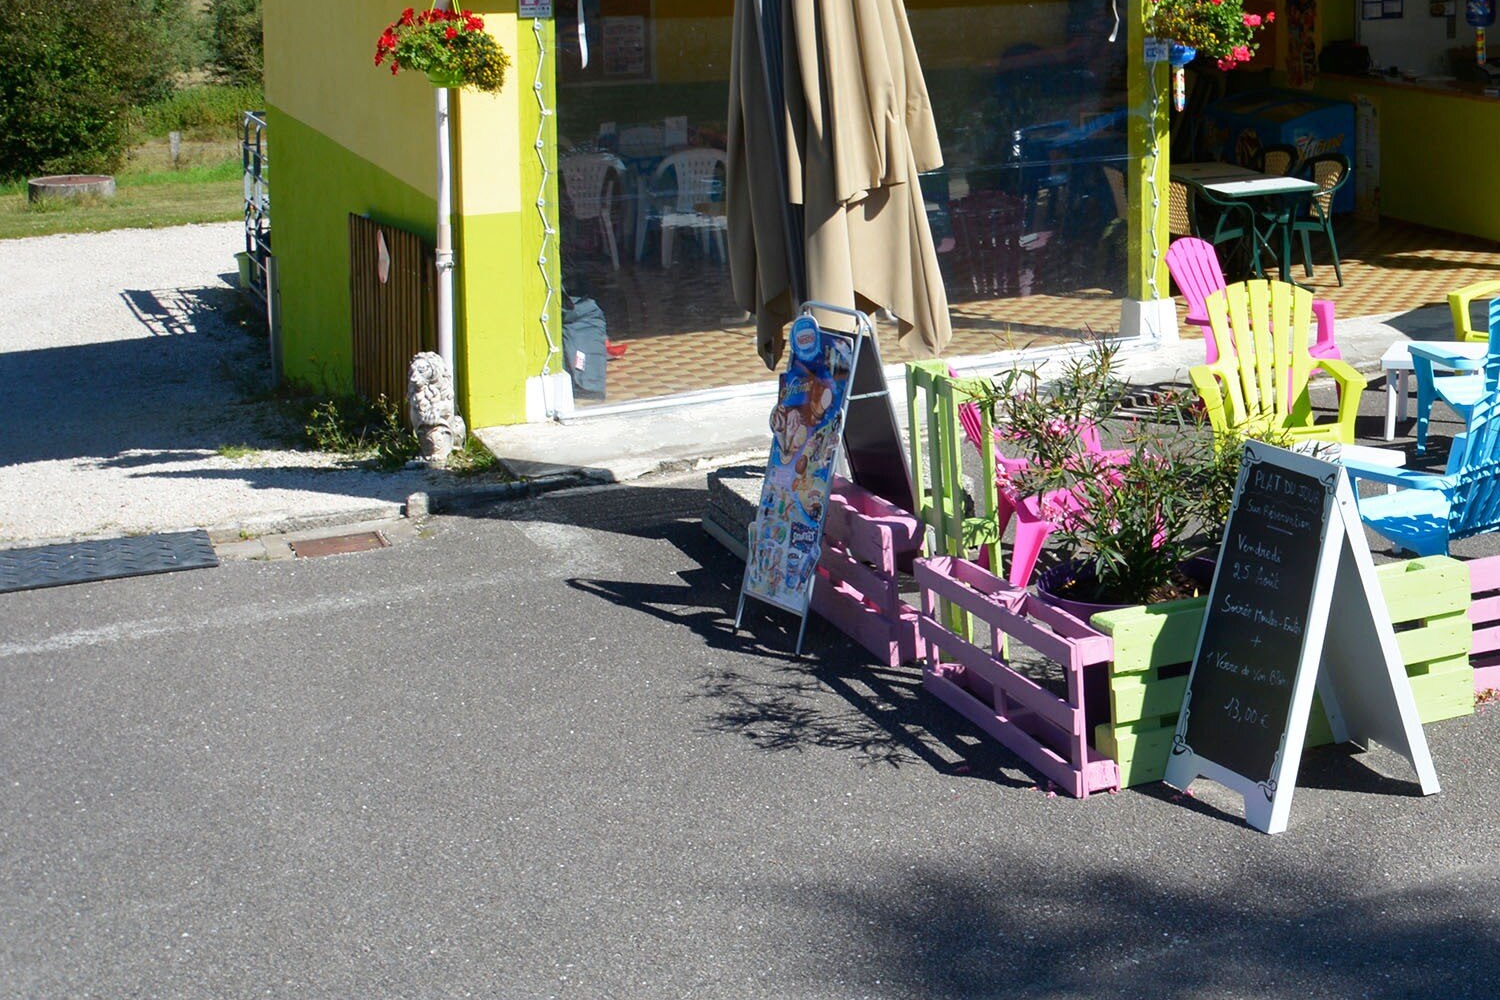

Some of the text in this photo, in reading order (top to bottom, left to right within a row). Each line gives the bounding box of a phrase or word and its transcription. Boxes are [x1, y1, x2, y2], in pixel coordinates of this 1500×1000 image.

[1255, 470, 1280, 491] PLAT
[1284, 479, 1297, 495] DU
[1238, 534, 1281, 563] Vendredi
[1233, 562, 1251, 579] 25
